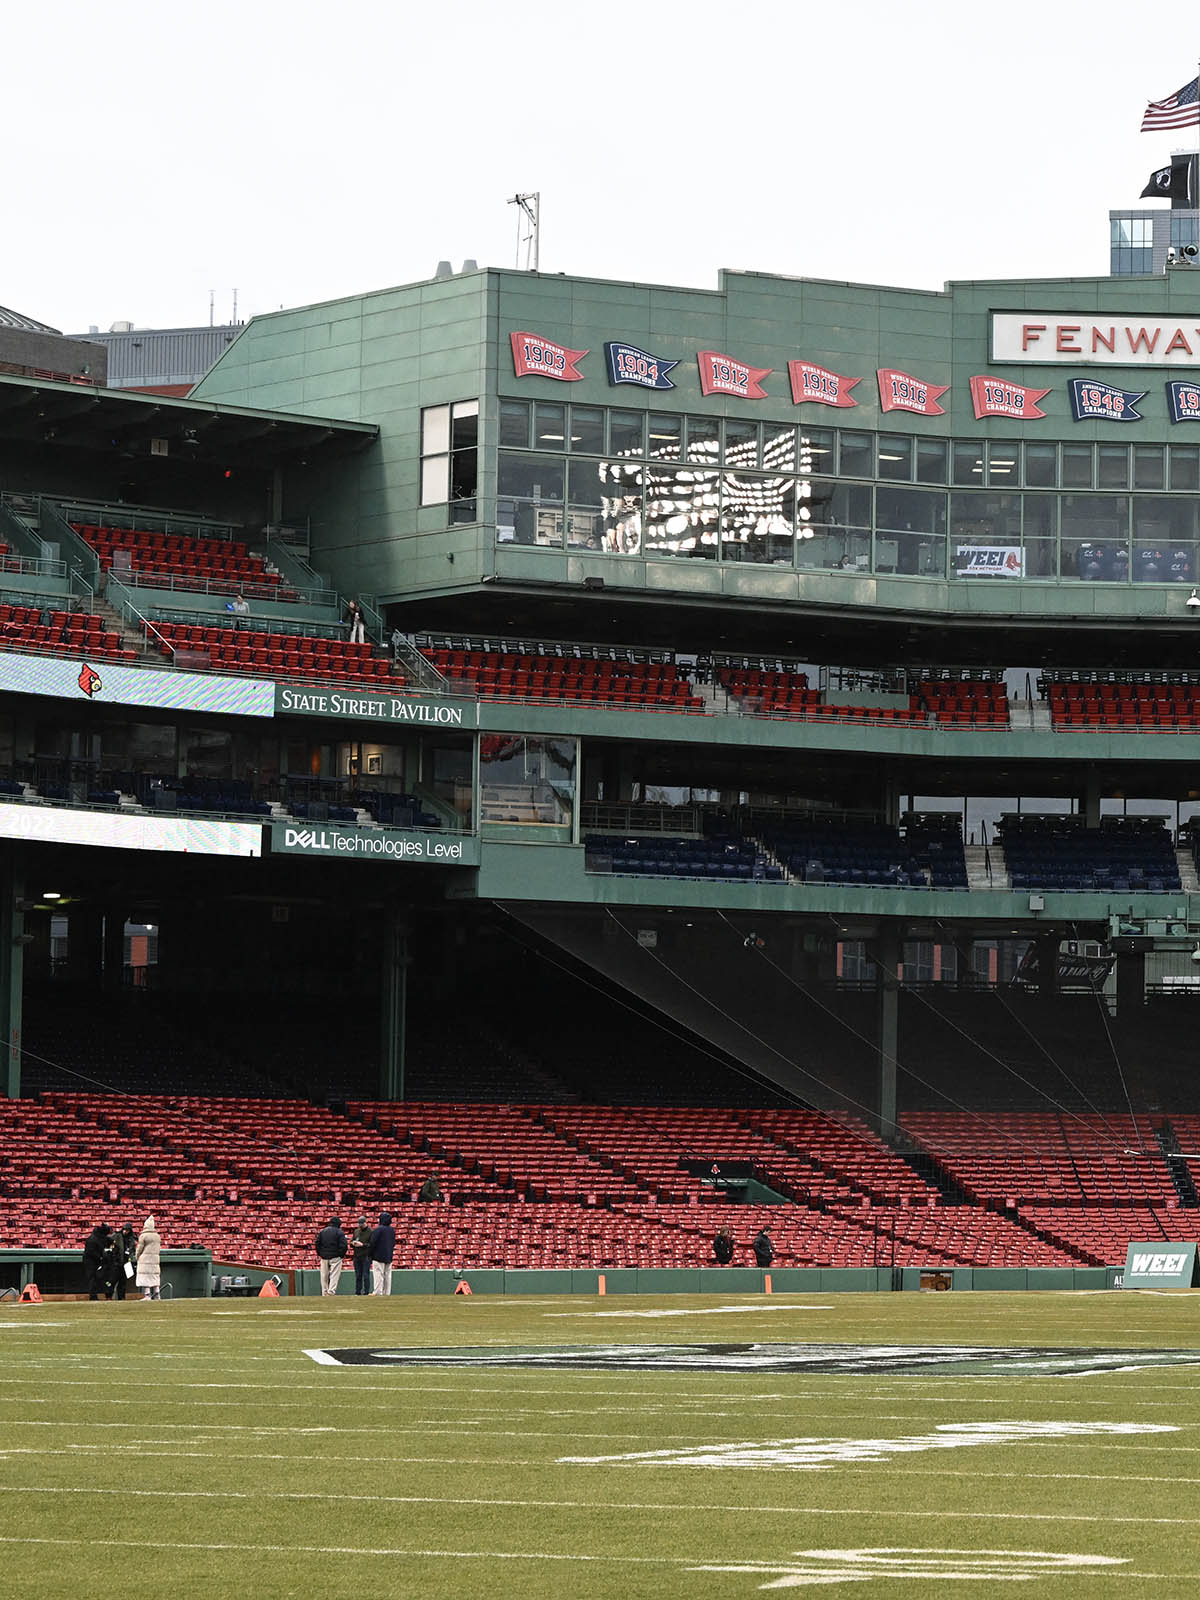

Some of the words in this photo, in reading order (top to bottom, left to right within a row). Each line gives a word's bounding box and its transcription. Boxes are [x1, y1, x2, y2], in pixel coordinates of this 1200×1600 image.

[524, 337, 545, 349] WORLD
[524, 344, 566, 371] 1903
[618, 348, 641, 359] AMERICAN
[526, 361, 563, 377] CHAMPIONS
[617, 354, 659, 381] 1904
[711, 356, 730, 367] WORLD
[712, 364, 749, 388] 1912
[801, 365, 821, 375] WORLD
[620, 371, 656, 386] CHAMPIONS
[803, 372, 839, 397] 1915
[890, 374, 910, 384] WORLD
[984, 380, 1005, 389] WORLD
[712, 380, 748, 396] CHAMPIONS
[891, 381, 928, 405] 1916
[1082, 384, 1105, 393] AMERICAN
[803, 389, 838, 403] CHAMPIONS
[985, 387, 1025, 409] 1918
[1081, 389, 1125, 412] 1946
[892, 397, 926, 412] CHAMPIONS
[986, 403, 1023, 416] CHAMPIONS
[1084, 406, 1122, 418] CHAMPIONS
[281, 690, 328, 713] STATE
[390, 699, 463, 724] PAVILION
[285, 829, 331, 849] DELL
[330, 832, 423, 859] Technologies
[426, 839, 463, 858] Level
[1131, 1254, 1188, 1273] WEEI
